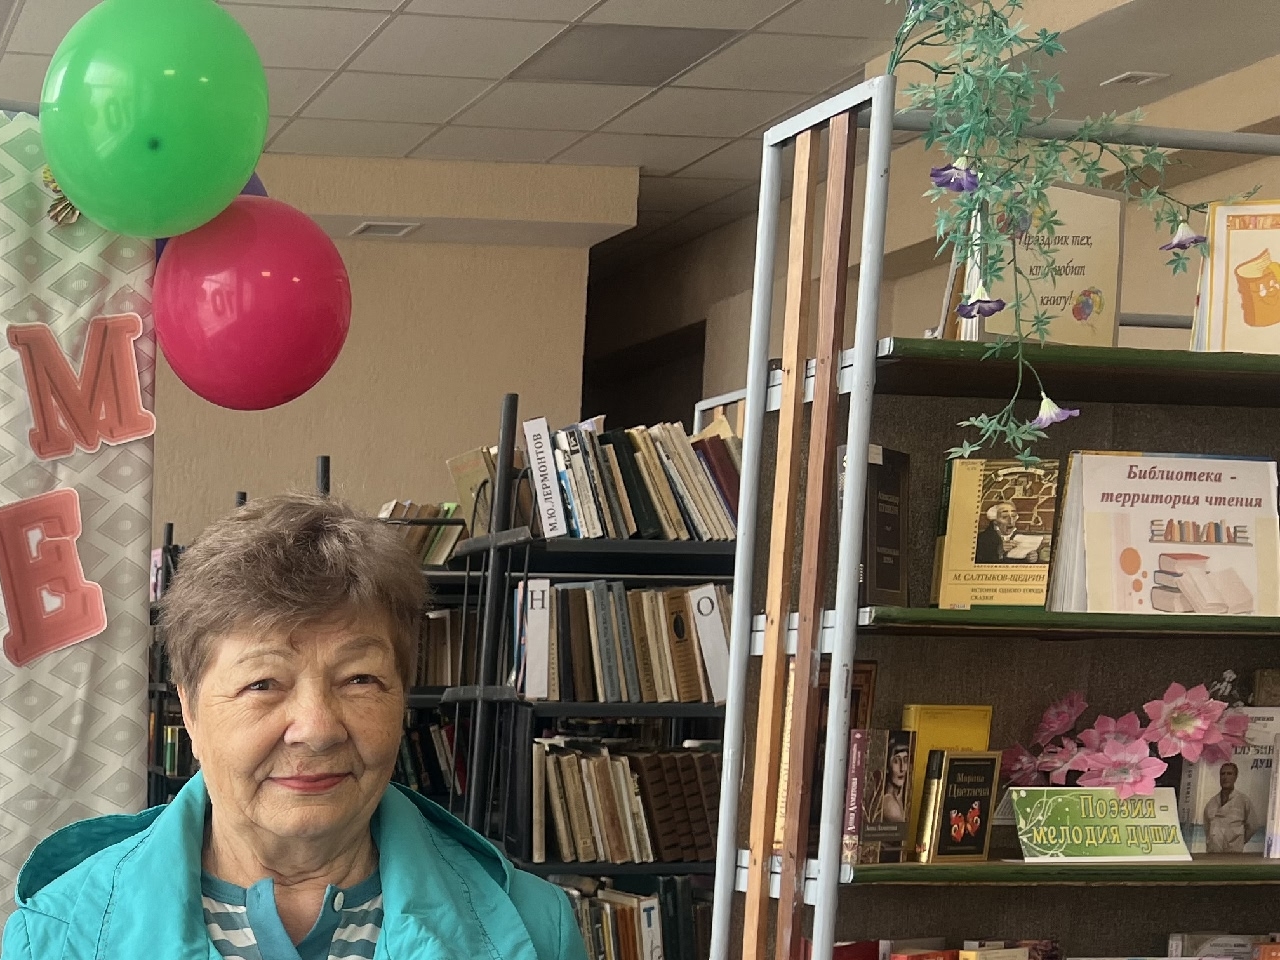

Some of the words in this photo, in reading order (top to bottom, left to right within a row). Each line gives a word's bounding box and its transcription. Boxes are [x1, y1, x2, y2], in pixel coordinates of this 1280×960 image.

[1071, 234, 1093, 248] тех,
[1039, 290, 1074, 311] книгу!
[1127, 464, 1223, 483] Библиотека
[1100, 491, 1200, 509] территория
[1205, 494, 1263, 508] чтения
[529, 589, 546, 611] Н
[948, 783, 991, 799] Цветаева
[1079, 793, 1156, 819] Поэзия
[1032, 824, 1122, 847] мелодия
[1125, 824, 1180, 853] души
[642, 906, 655, 929] Т
